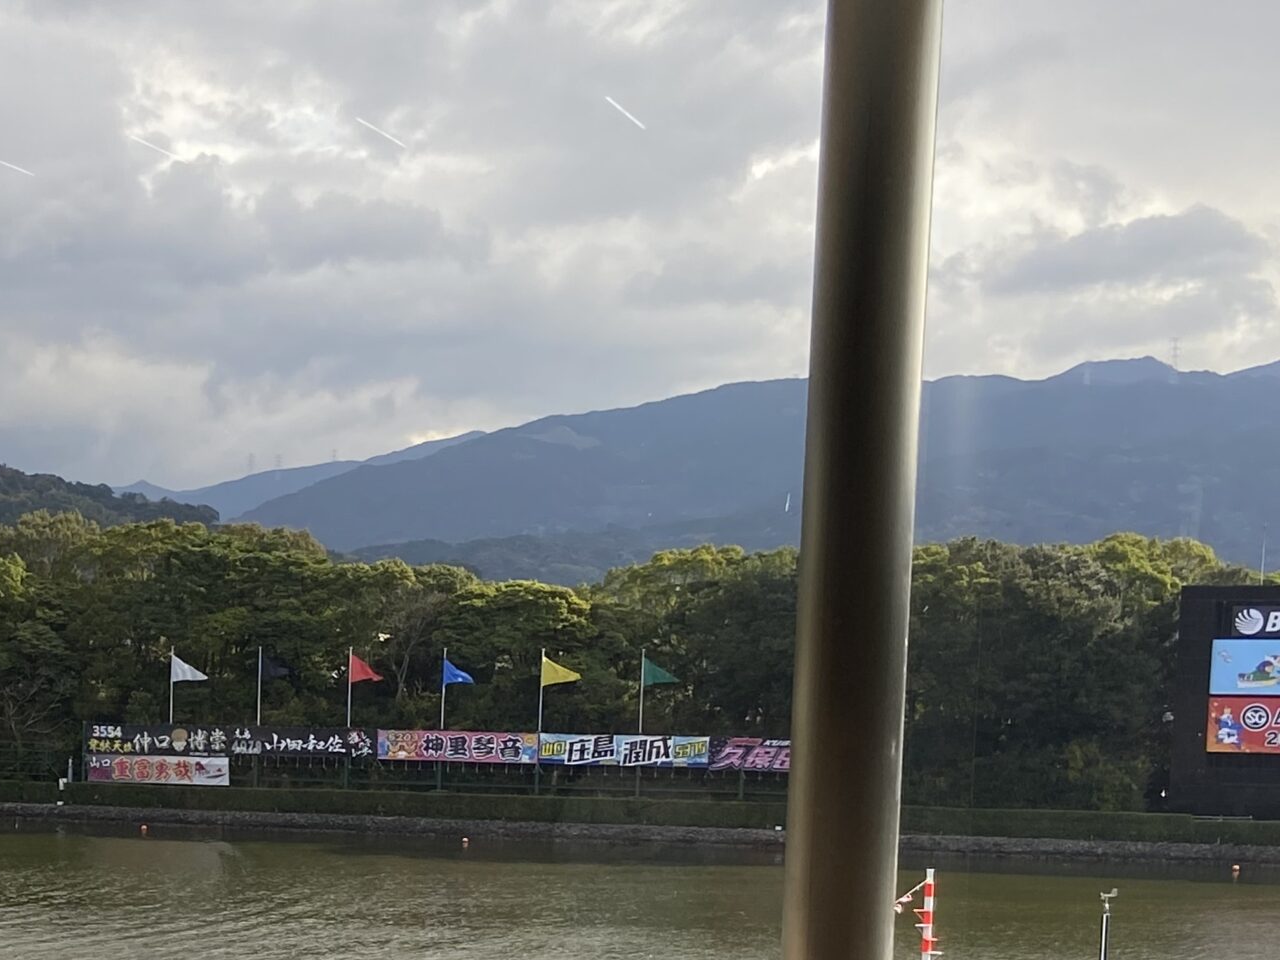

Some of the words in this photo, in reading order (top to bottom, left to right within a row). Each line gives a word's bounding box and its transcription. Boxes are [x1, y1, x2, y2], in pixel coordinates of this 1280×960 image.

[92, 725, 122, 738] 3554
[423, 734, 522, 761] 神里琴音
[89, 756, 111, 768] 山口
